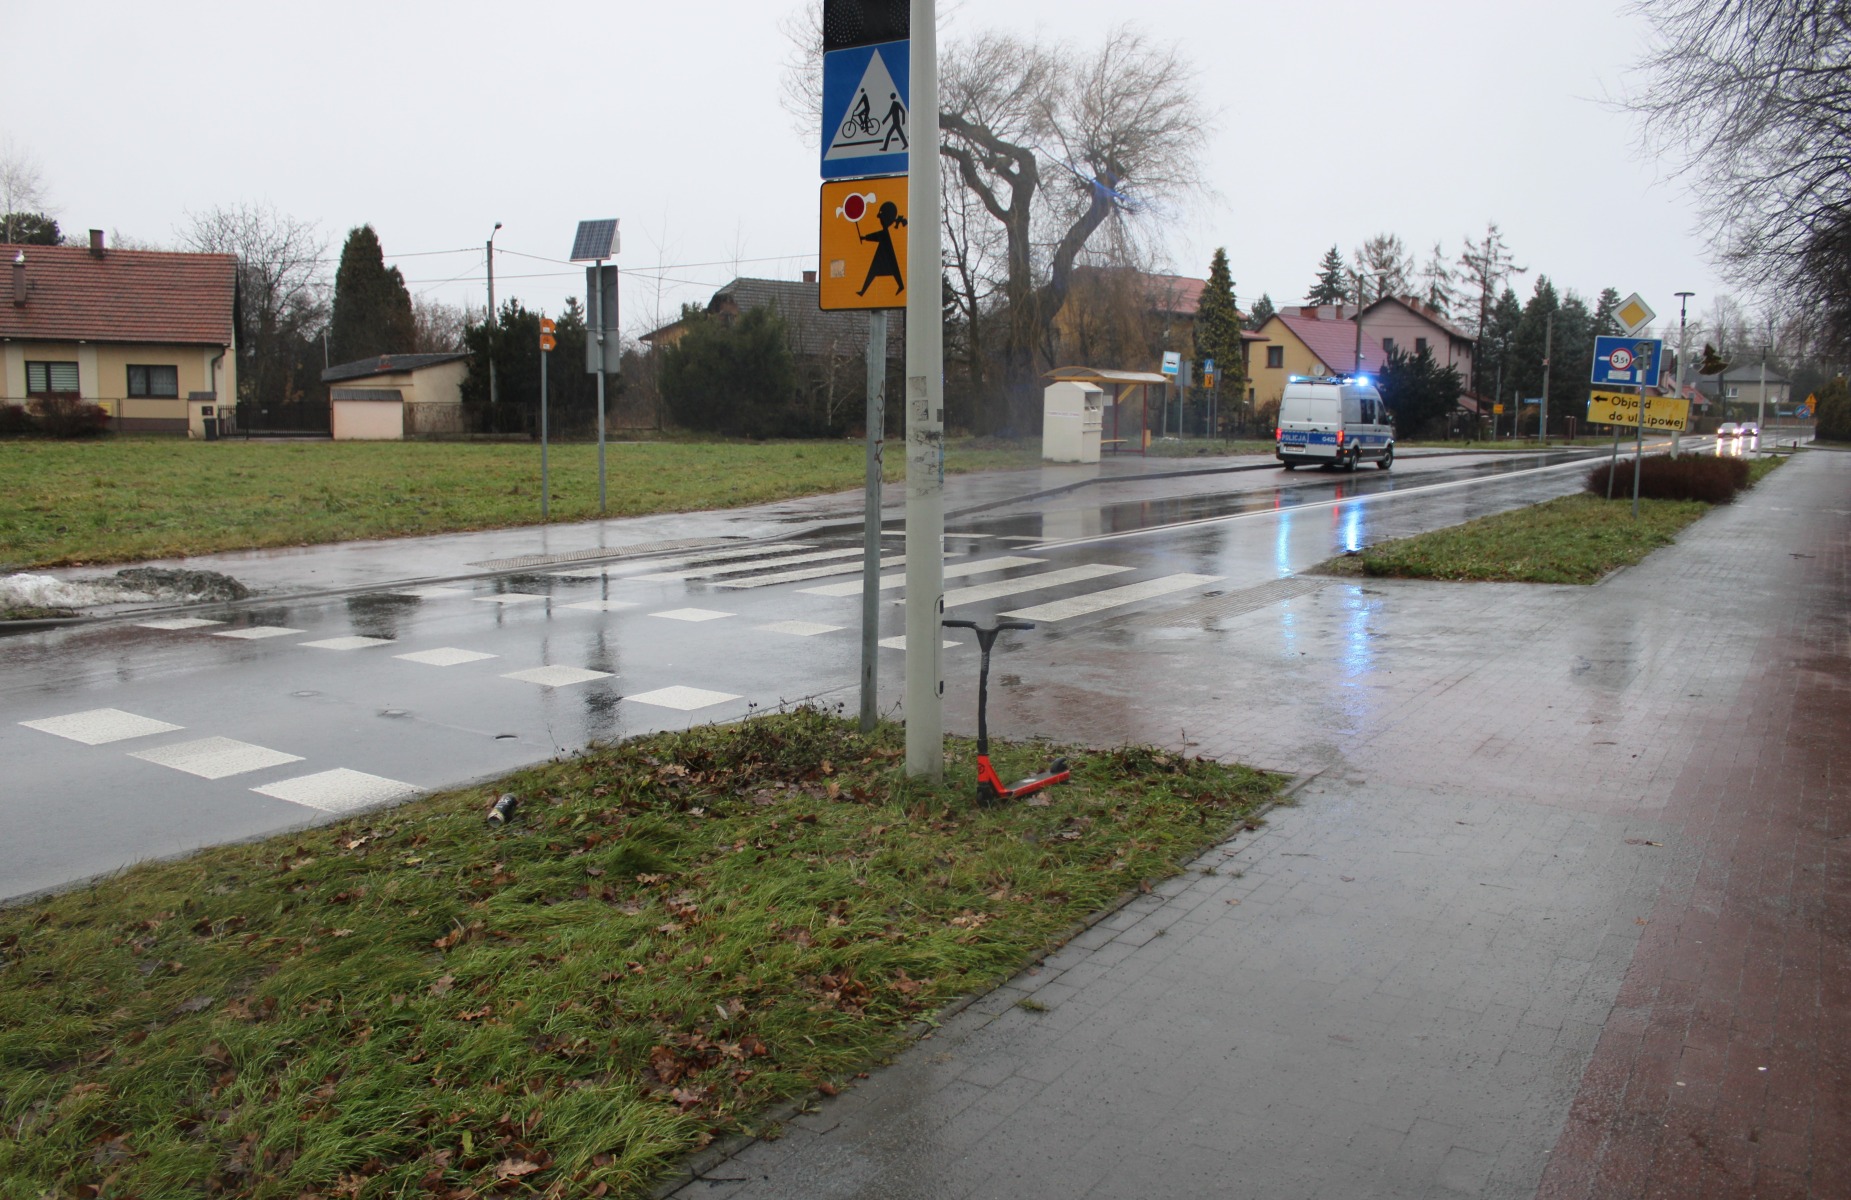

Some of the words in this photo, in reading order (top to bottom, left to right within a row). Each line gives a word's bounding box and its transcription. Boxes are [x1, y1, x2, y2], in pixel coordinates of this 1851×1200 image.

[1611, 396, 1651, 409] Objad
[1609, 411, 1622, 421] do
[1282, 434, 1306, 442] POLICJA
